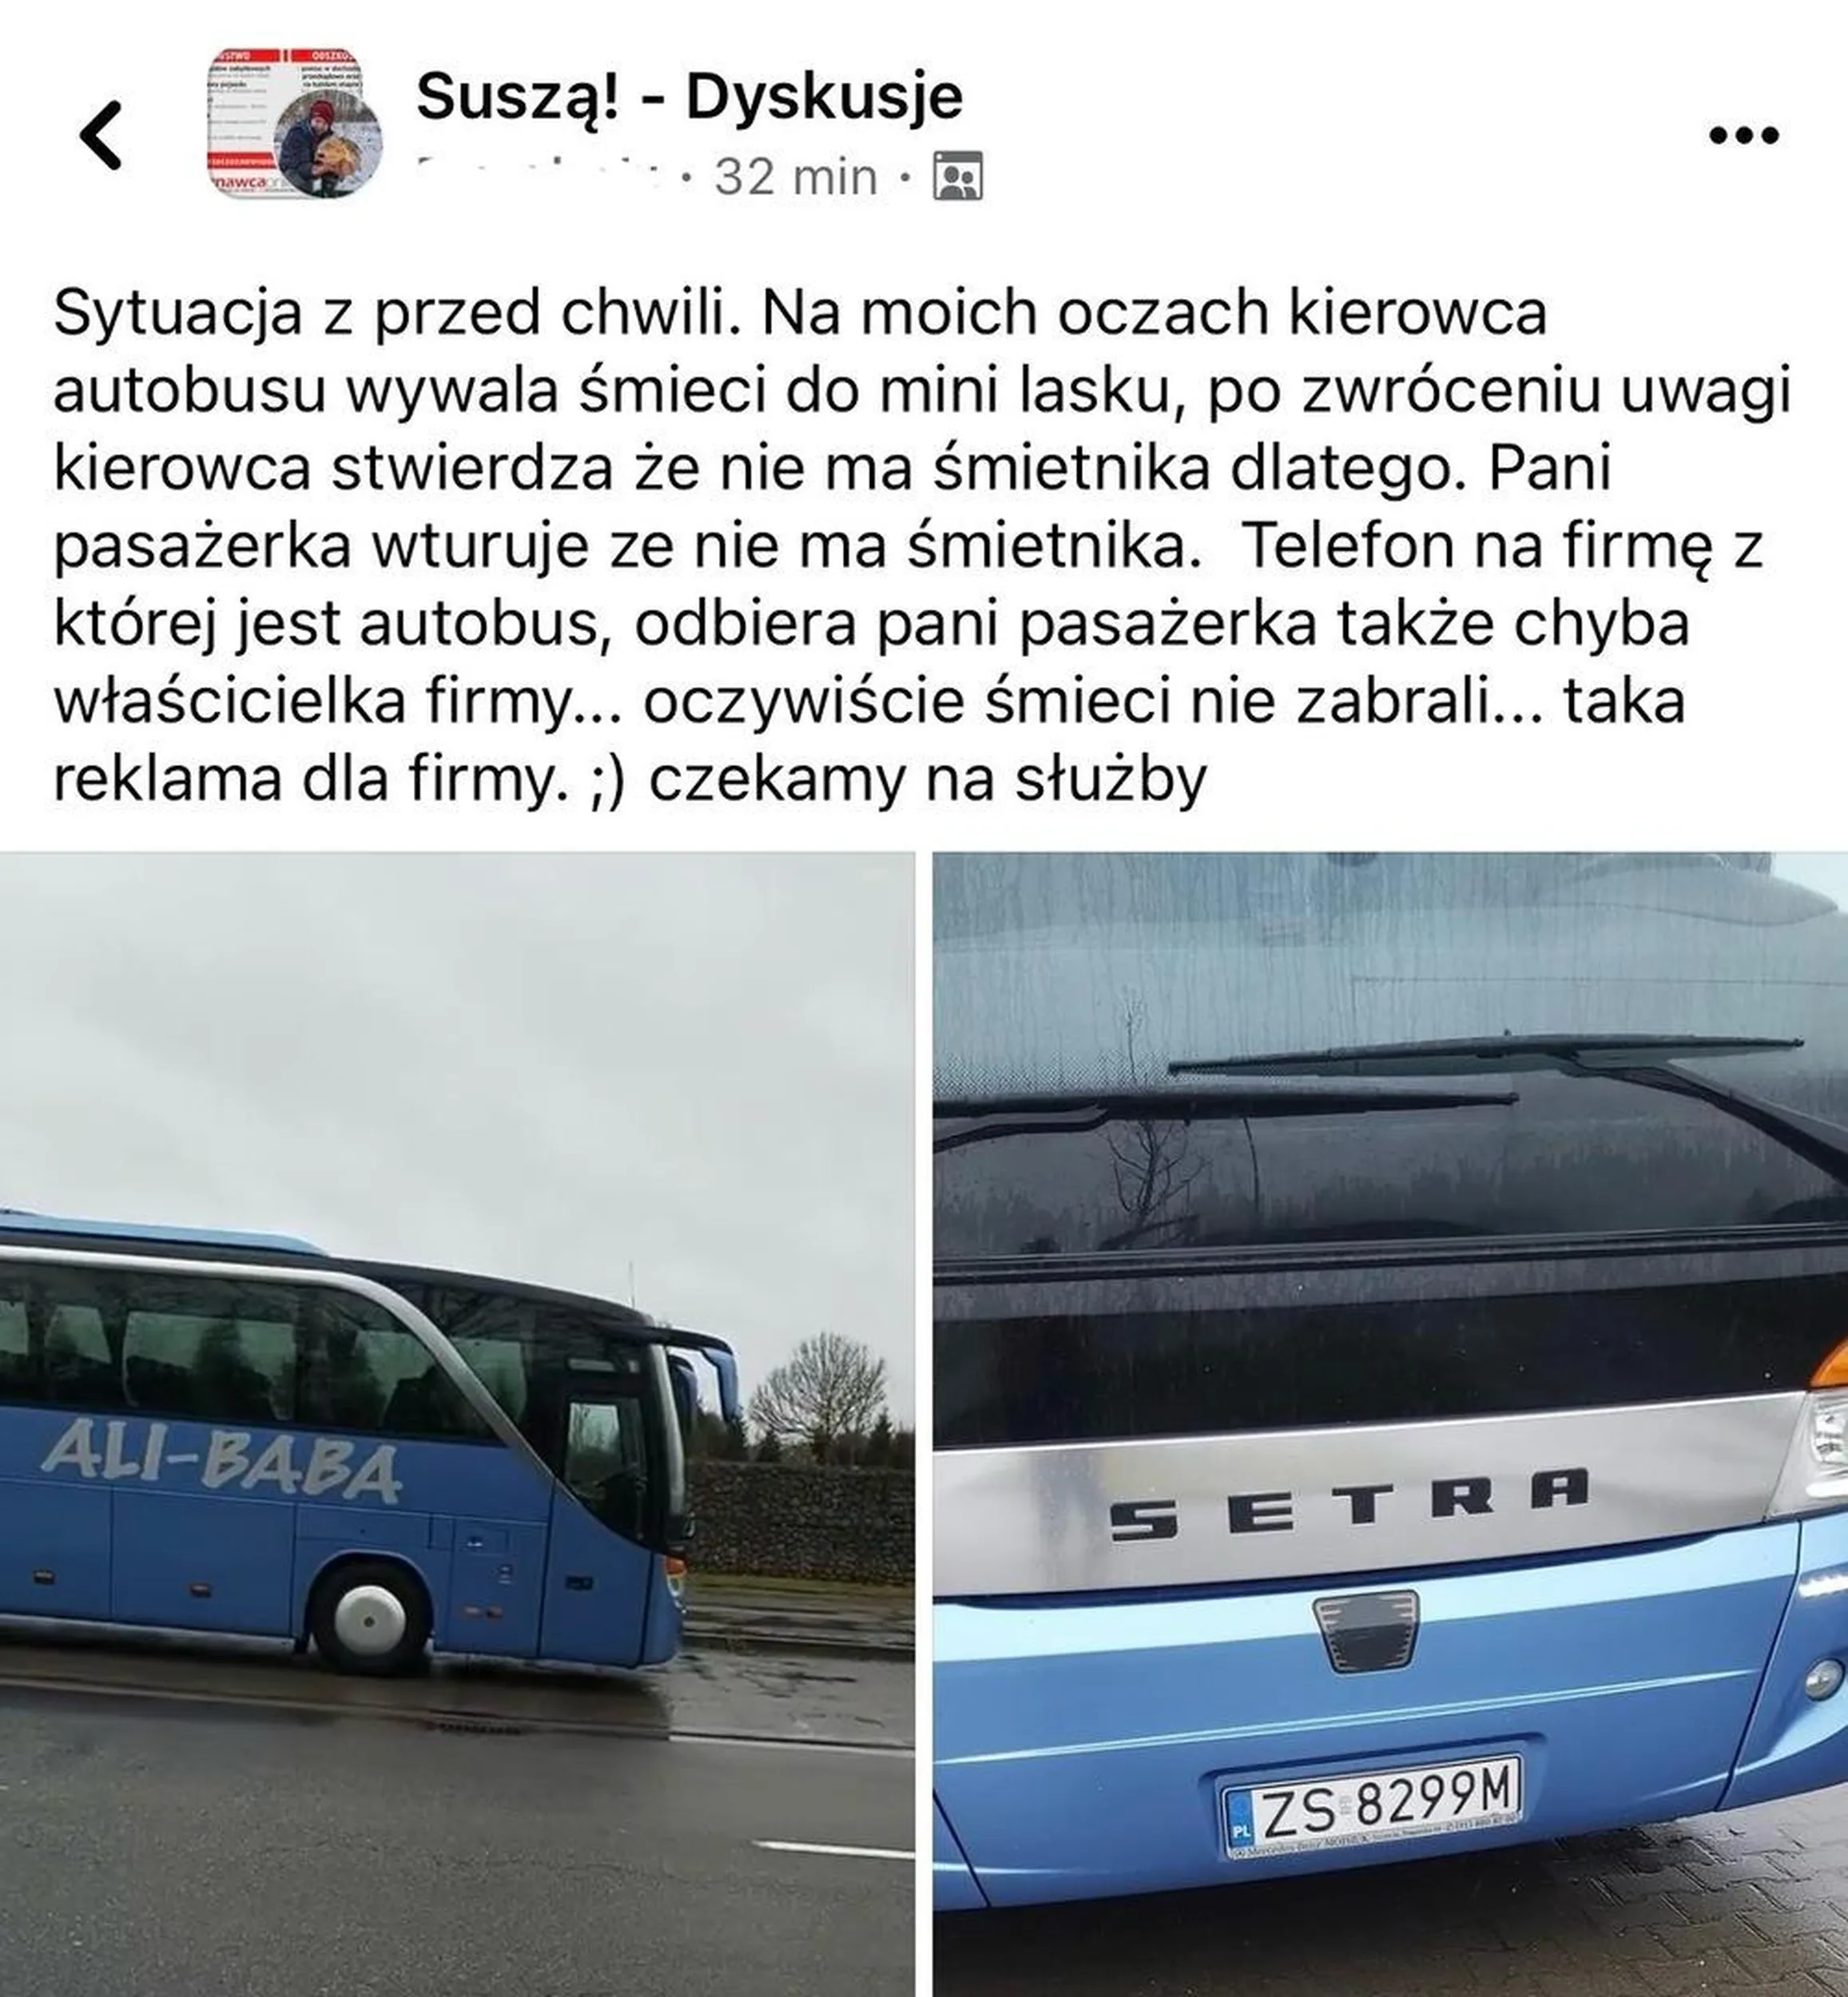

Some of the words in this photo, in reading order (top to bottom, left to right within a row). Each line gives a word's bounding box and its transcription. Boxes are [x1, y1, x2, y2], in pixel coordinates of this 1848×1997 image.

[41, 1418, 403, 1505] ALI-BABA
[1111, 1467, 1590, 1542] SETRA
[1233, 1825, 1251, 1838] PL
[1262, 1788, 1335, 1838] ZS
[1357, 1765, 1510, 1826] 8299M
